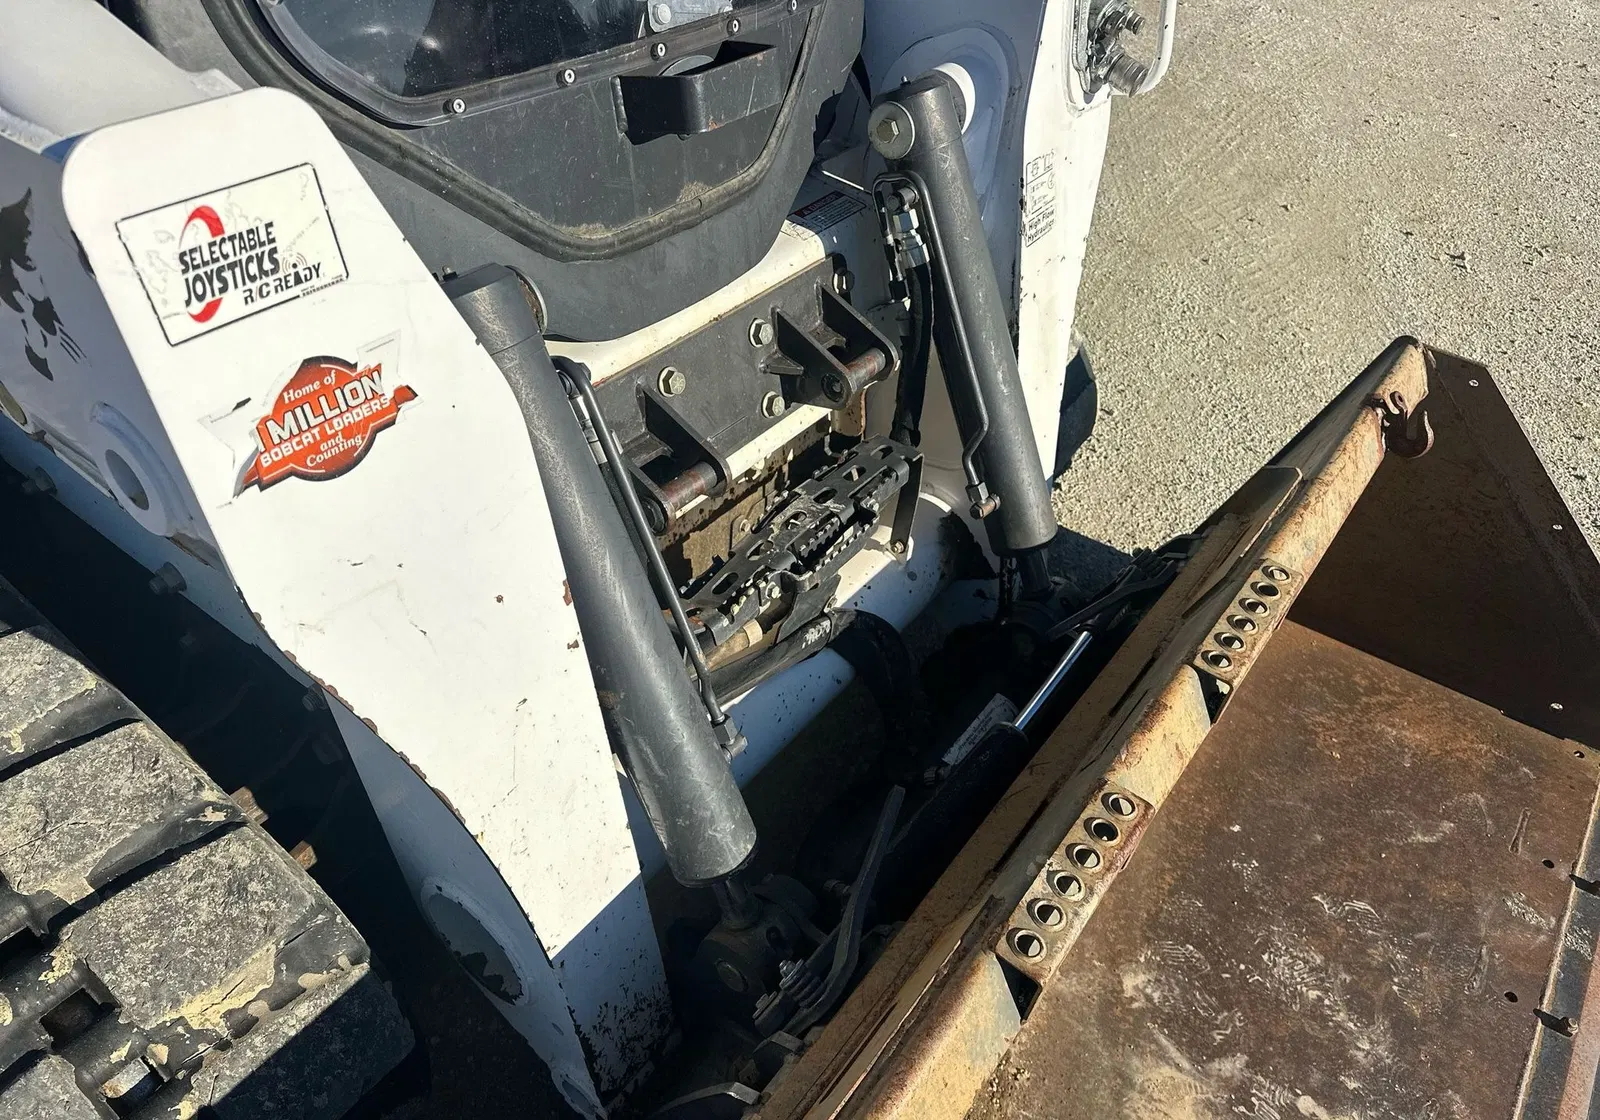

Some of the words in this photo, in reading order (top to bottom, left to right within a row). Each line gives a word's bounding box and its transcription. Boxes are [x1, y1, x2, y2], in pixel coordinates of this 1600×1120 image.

[1027, 218, 1055, 243] Hydraulics
[1028, 217, 1041, 231] High
[1042, 209, 1055, 222] Flow
[179, 221, 276, 275] SELECTABLE
[184, 246, 280, 308] JOYSTICKS
[273, 262, 321, 294] READY
[282, 380, 321, 404] Home
[323, 369, 336, 386] of
[265, 369, 384, 445] MILLION
[260, 428, 321, 468] BOBCAT
[324, 396, 391, 436] LOADERS
[320, 432, 343, 452] and
[306, 434, 363, 467] Counting
